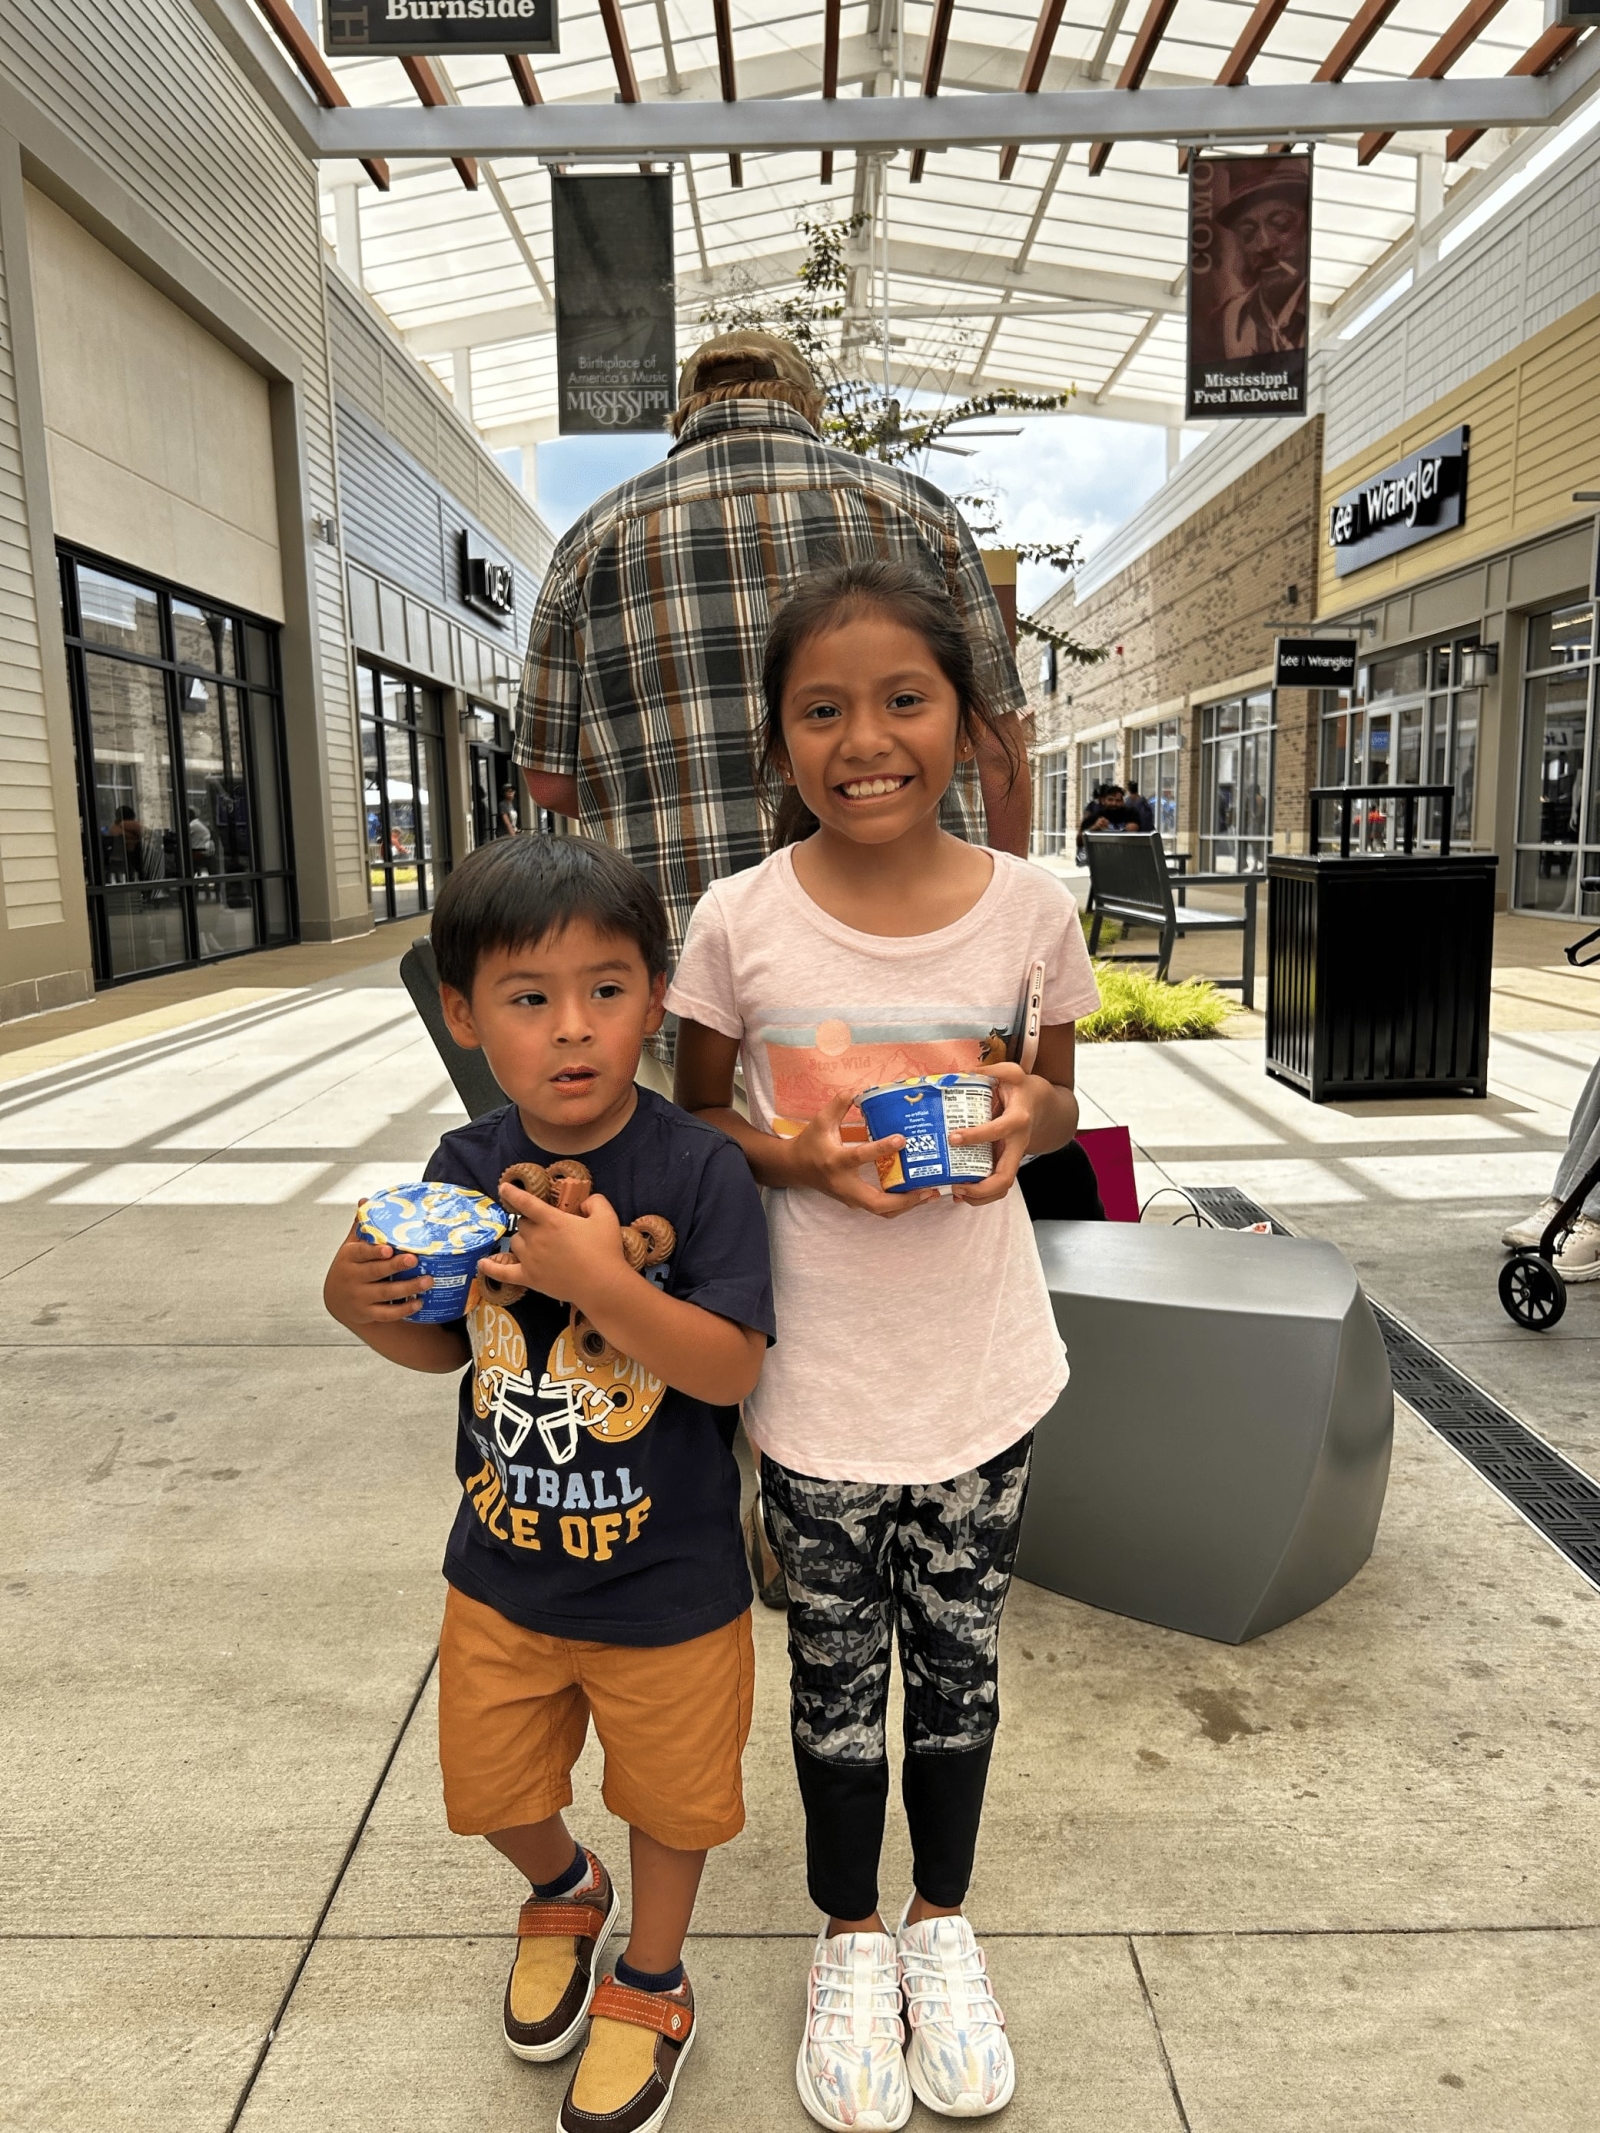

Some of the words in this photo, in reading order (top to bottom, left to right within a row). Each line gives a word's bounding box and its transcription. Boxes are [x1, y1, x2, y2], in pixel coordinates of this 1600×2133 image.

[385, 0, 535, 20] Burnside
[1191, 161, 1213, 275] COMO
[578, 354, 640, 373] Birthplace
[643, 353, 657, 368] of
[568, 371, 629, 384] America's
[631, 370, 669, 383] Music
[1204, 371, 1288, 389] Mississippi
[1194, 388, 1227, 404] Fred
[1230, 387, 1299, 402] McDowell
[566, 390, 670, 425] MISSISSIPPI
[1328, 503, 1354, 547] Lee
[1366, 456, 1443, 529] Wrangler
[1280, 653, 1299, 667] Lee
[1308, 654, 1355, 672] Wrangler
[808, 1058, 840, 1074] Stay
[841, 1056, 871, 1069] Wild
[484, 1304, 526, 1369] BRO
[465, 1458, 542, 1551] FACE
[558, 1496, 652, 1562] OFF
